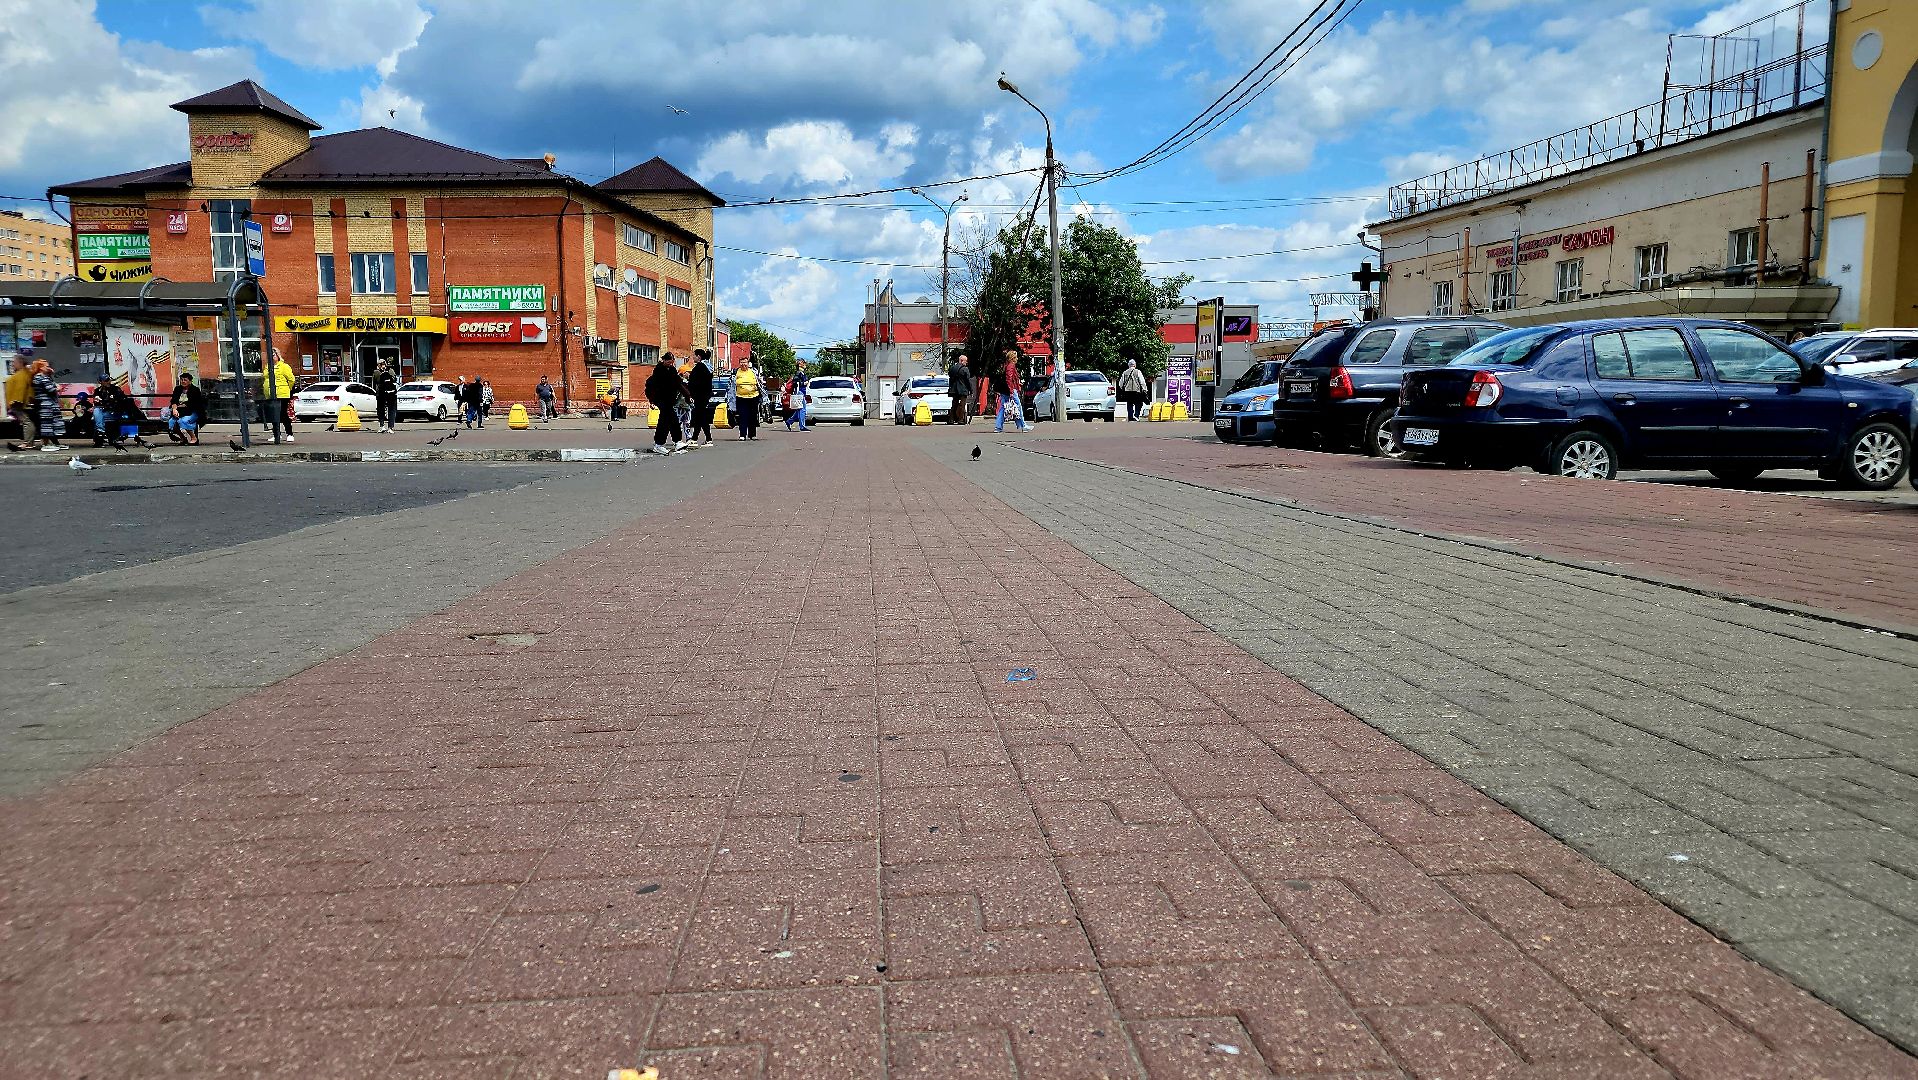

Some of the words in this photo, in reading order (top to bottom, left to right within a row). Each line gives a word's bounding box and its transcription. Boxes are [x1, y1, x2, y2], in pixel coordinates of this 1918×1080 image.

[169, 214, 184, 225] 24
[452, 287, 542, 300] ПАМЯТНИКИ
[336, 317, 416, 331] ПРОДУКТЫ
[458, 321, 513, 333] ФОНБЕТ
